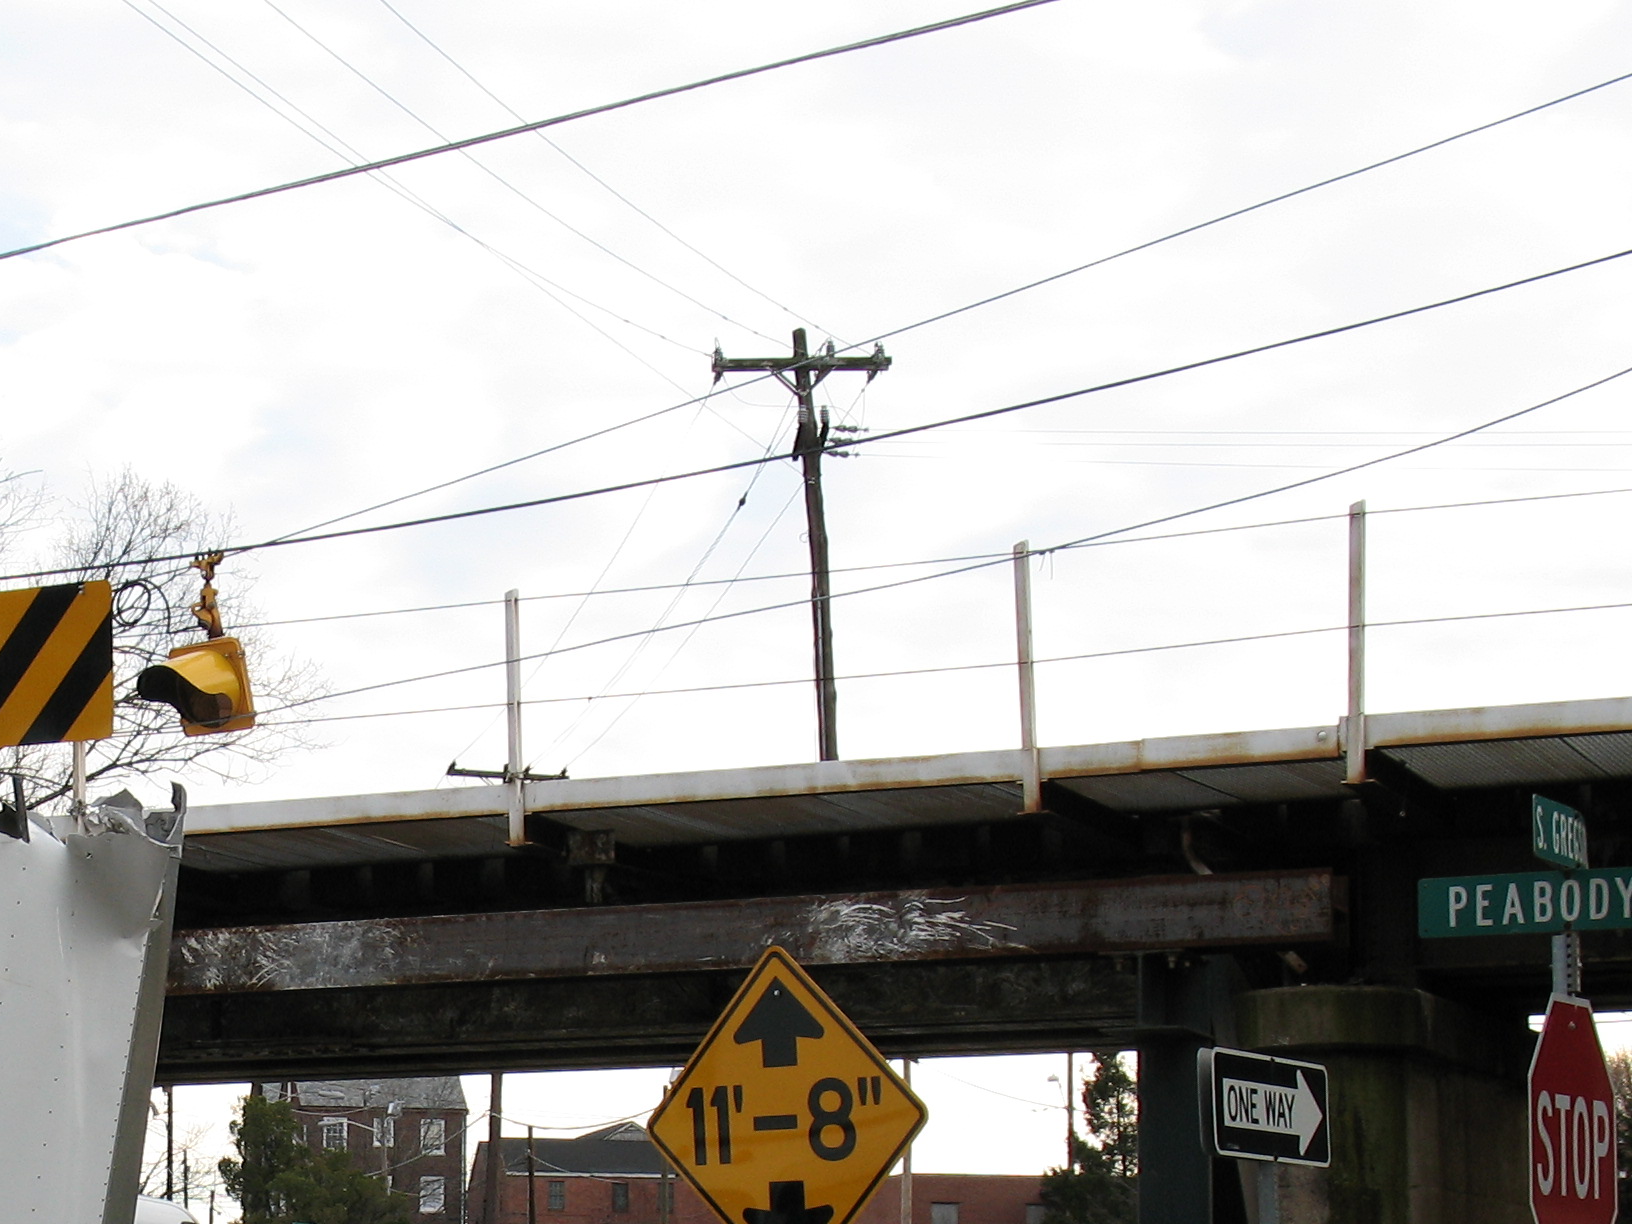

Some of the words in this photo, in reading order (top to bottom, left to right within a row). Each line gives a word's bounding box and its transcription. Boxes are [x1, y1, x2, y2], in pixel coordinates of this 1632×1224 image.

[1448, 876, 1632, 928] PEABODY
[1228, 1085, 1259, 1125] ONE
[1264, 1090, 1295, 1129] WAY
[1537, 1090, 1610, 1199] STOP
